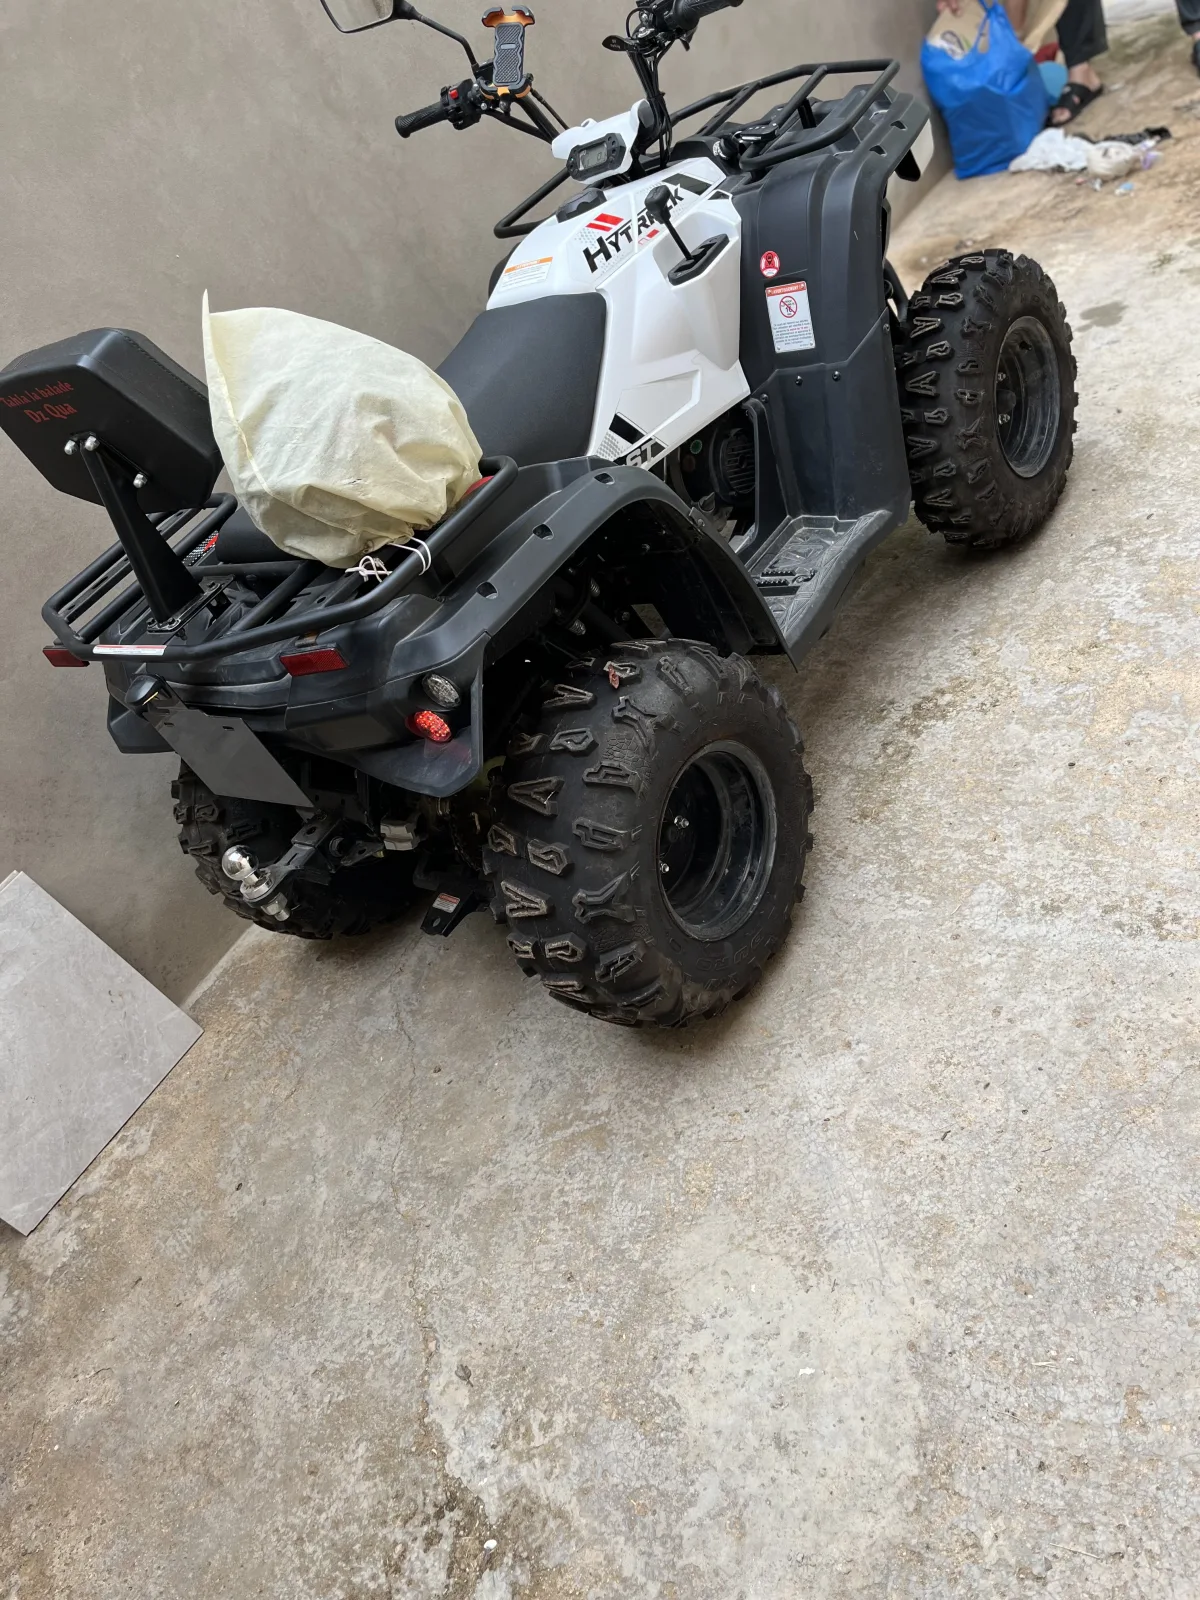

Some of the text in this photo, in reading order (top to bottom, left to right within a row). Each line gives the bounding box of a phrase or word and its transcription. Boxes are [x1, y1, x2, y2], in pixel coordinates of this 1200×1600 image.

[583, 187, 684, 273] HYTRK
[35, 381, 74, 398] balade
[23, 403, 78, 424] Dz Qua
